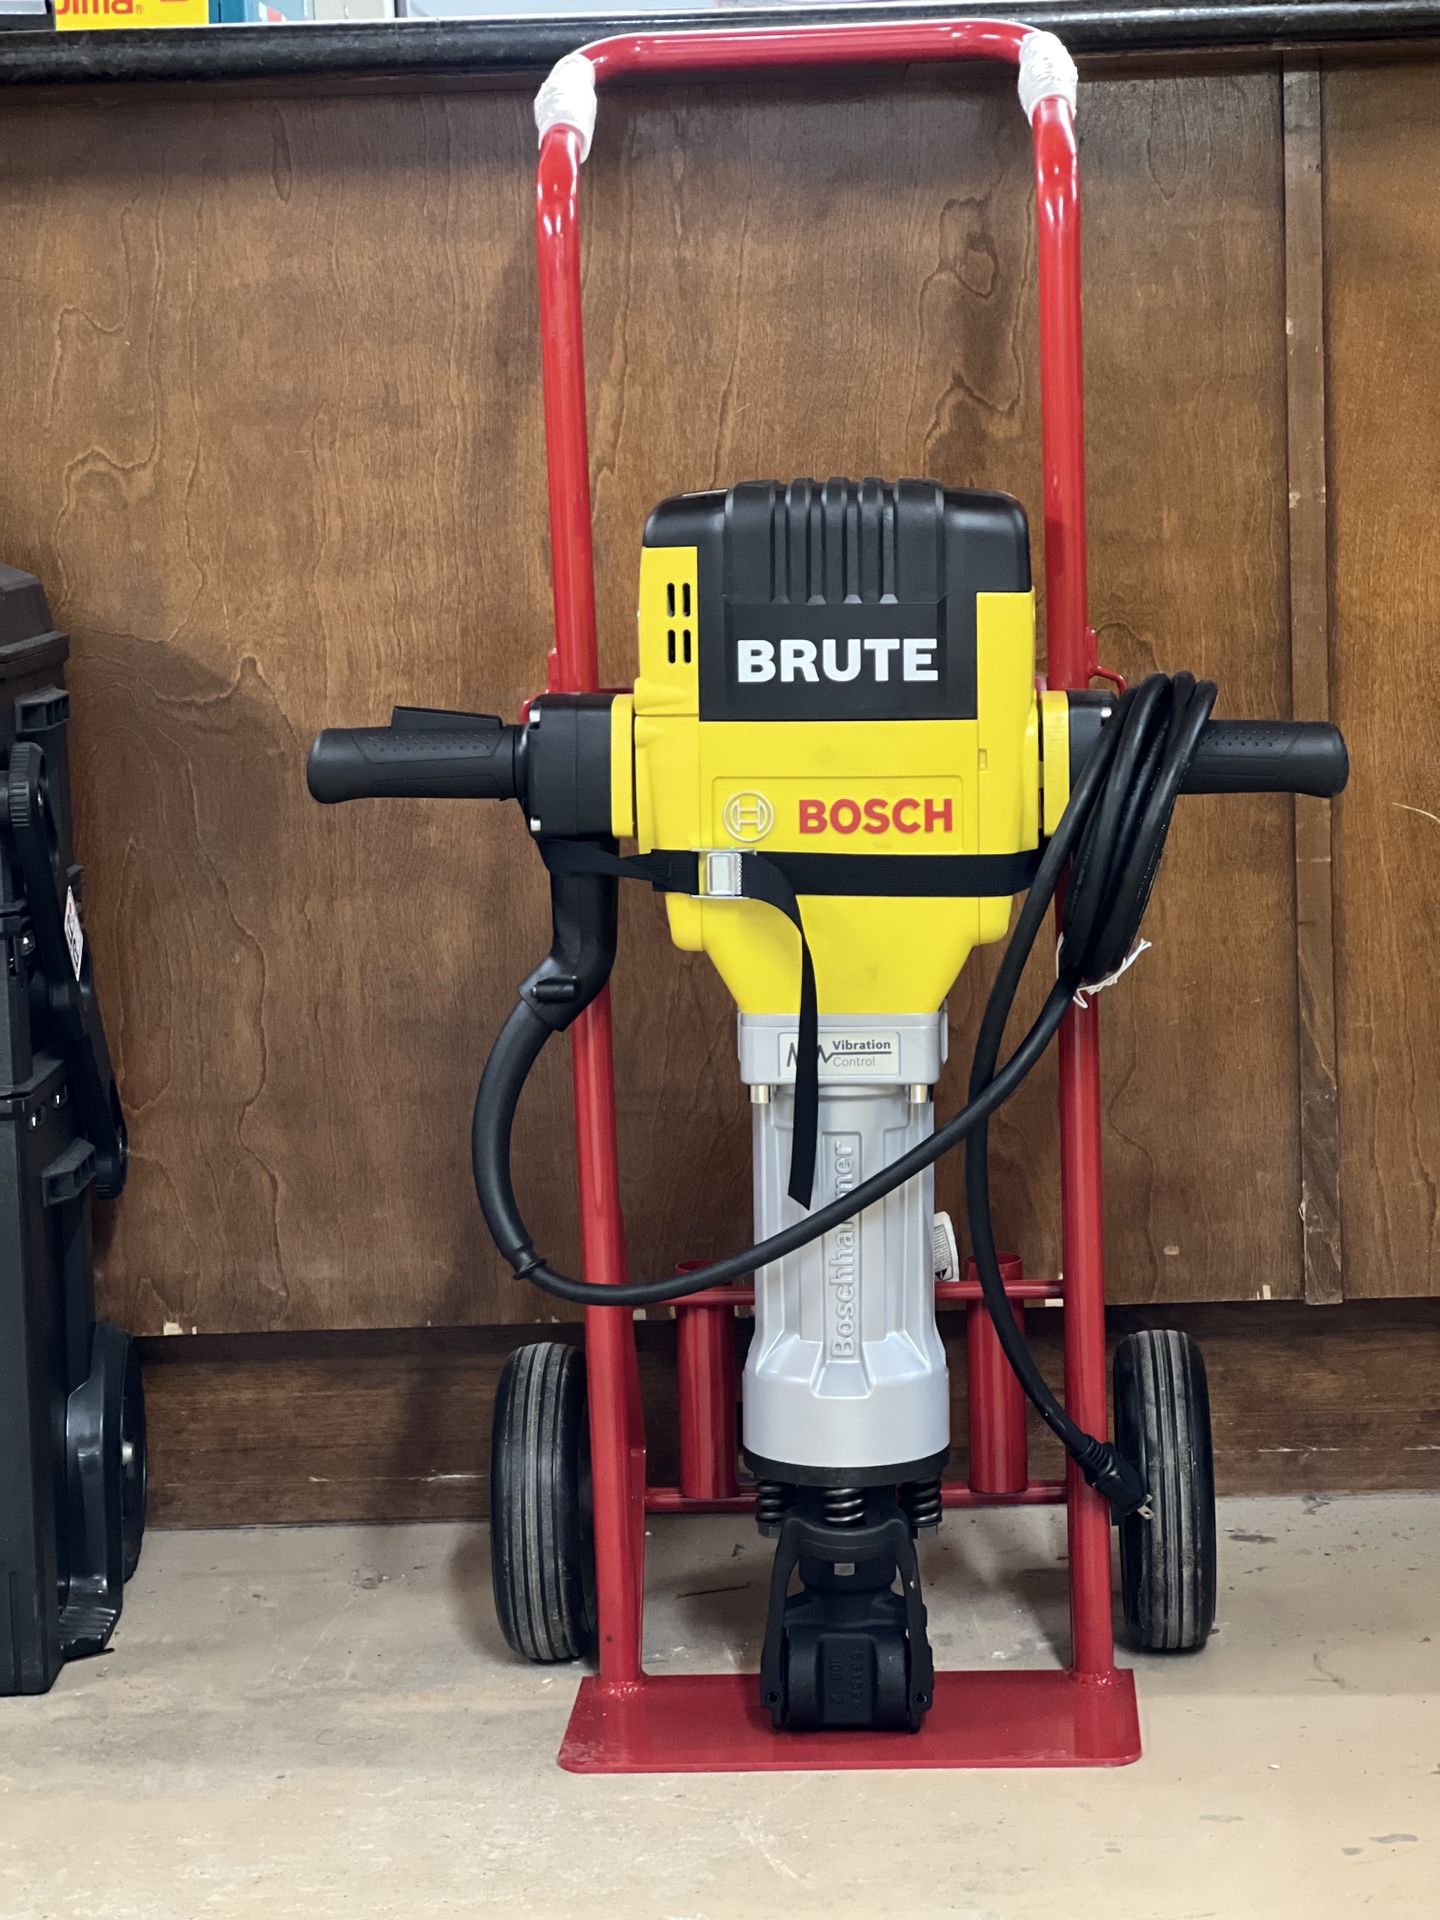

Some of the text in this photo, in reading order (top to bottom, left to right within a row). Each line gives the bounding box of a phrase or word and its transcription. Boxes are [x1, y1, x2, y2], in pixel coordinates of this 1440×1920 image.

[737, 638, 939, 683] BRUTE
[799, 798, 953, 834] BOSCH
[832, 1040, 891, 1050] Vibration
[832, 1056, 876, 1067] Control
[829, 1140, 855, 1358] Boschhamer
